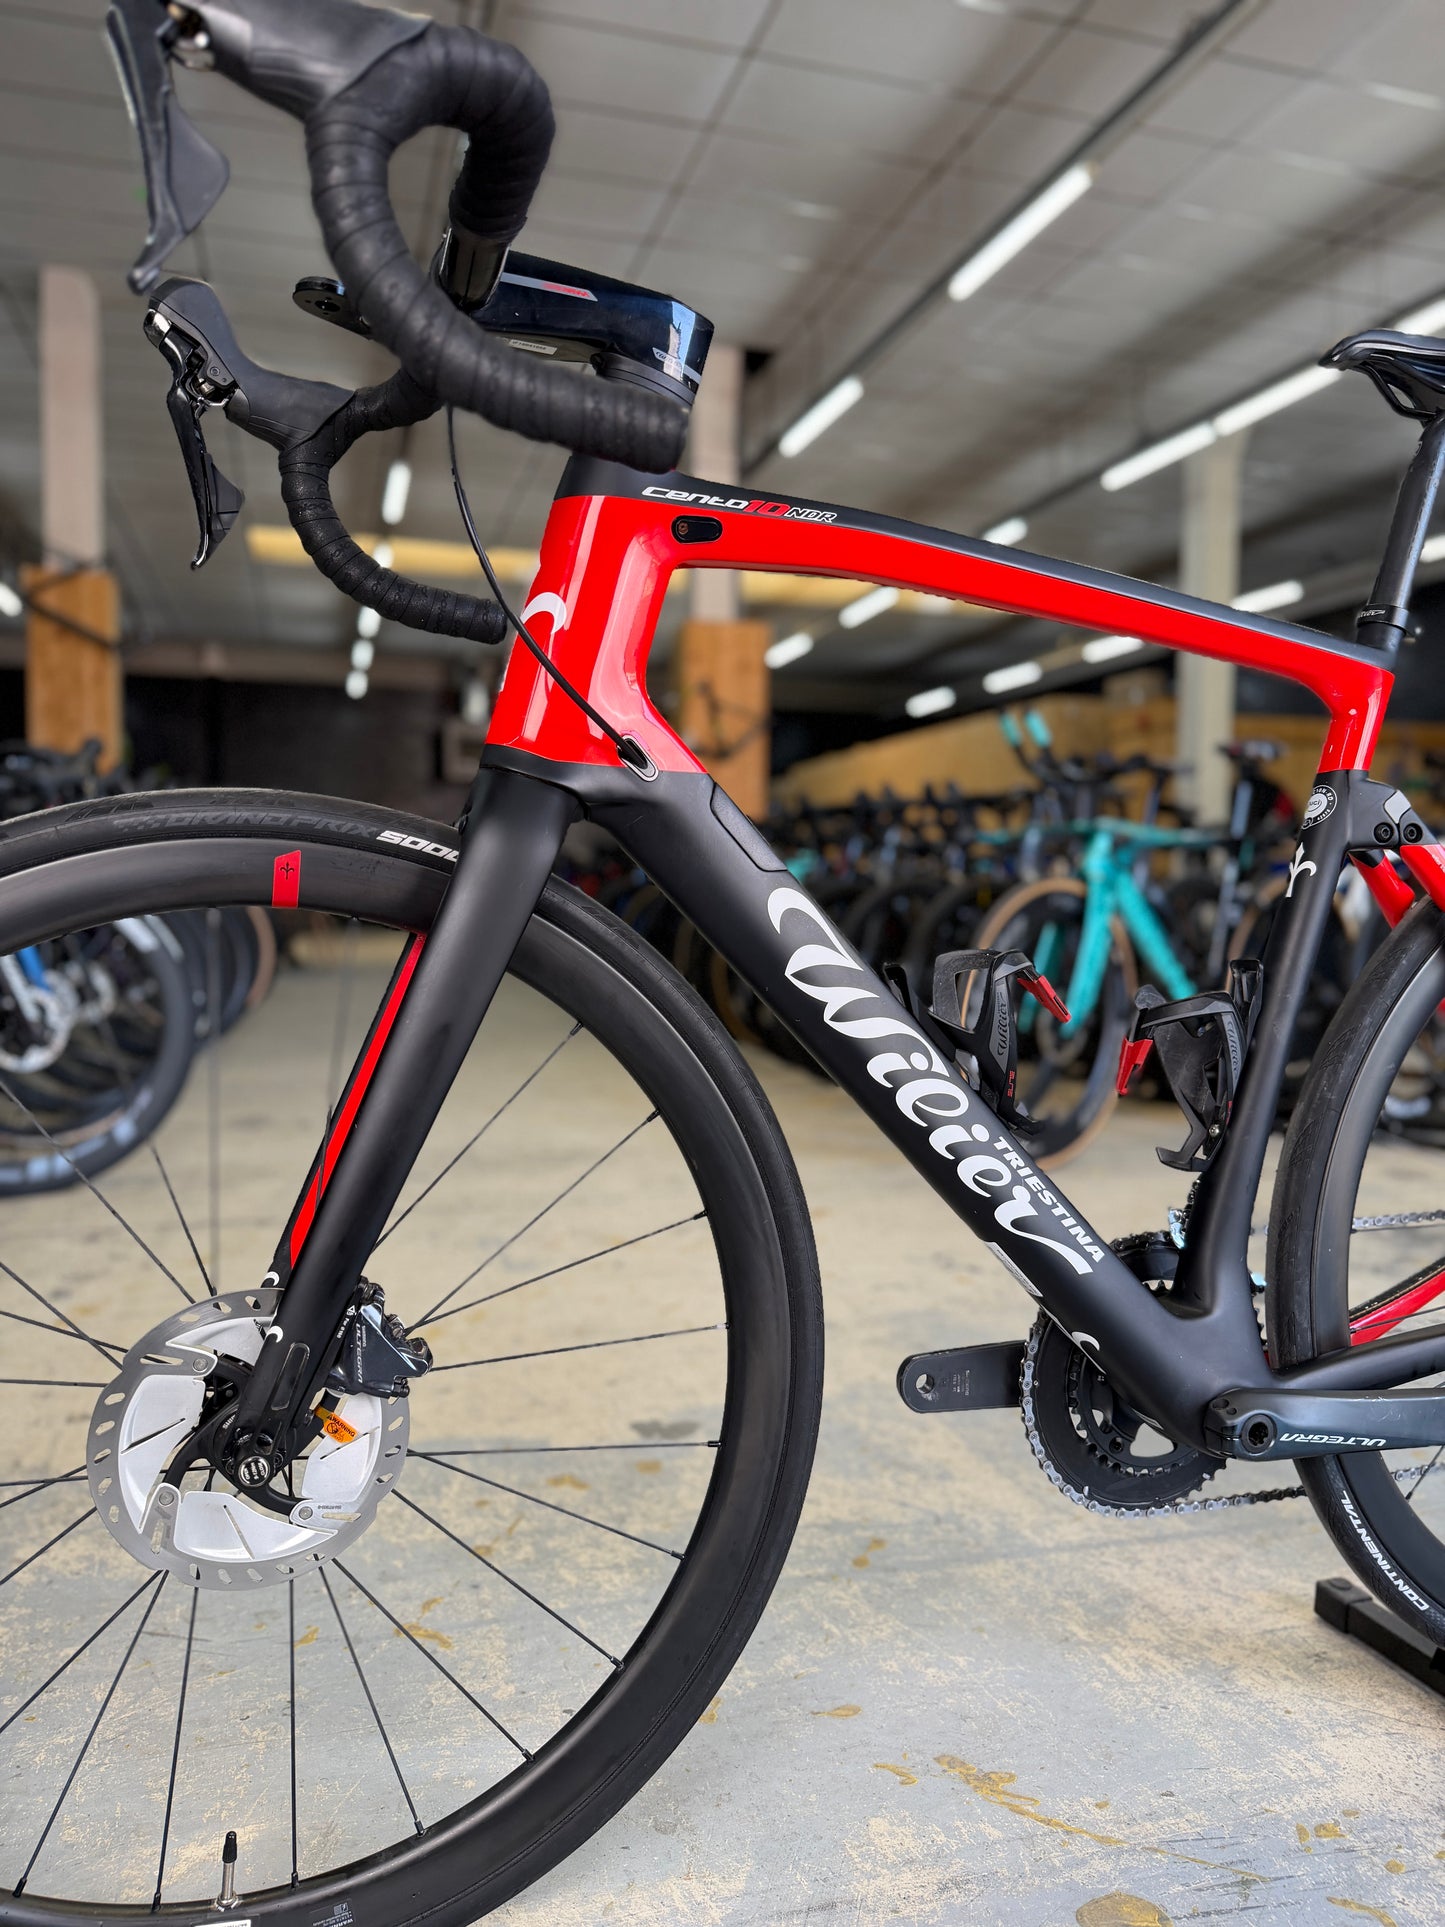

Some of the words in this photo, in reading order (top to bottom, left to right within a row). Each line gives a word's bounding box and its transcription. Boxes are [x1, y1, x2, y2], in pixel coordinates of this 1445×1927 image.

[294, 812, 378, 839] PRIX
[767, 887, 1093, 1275] Wilier
[993, 1136, 1105, 1263] TRIESTINA
[355, 1323, 363, 1384] ULTEGRA
[1280, 1433, 1386, 1447] ULTEGRA
[1340, 1490, 1430, 1611] CONTINENTAL
